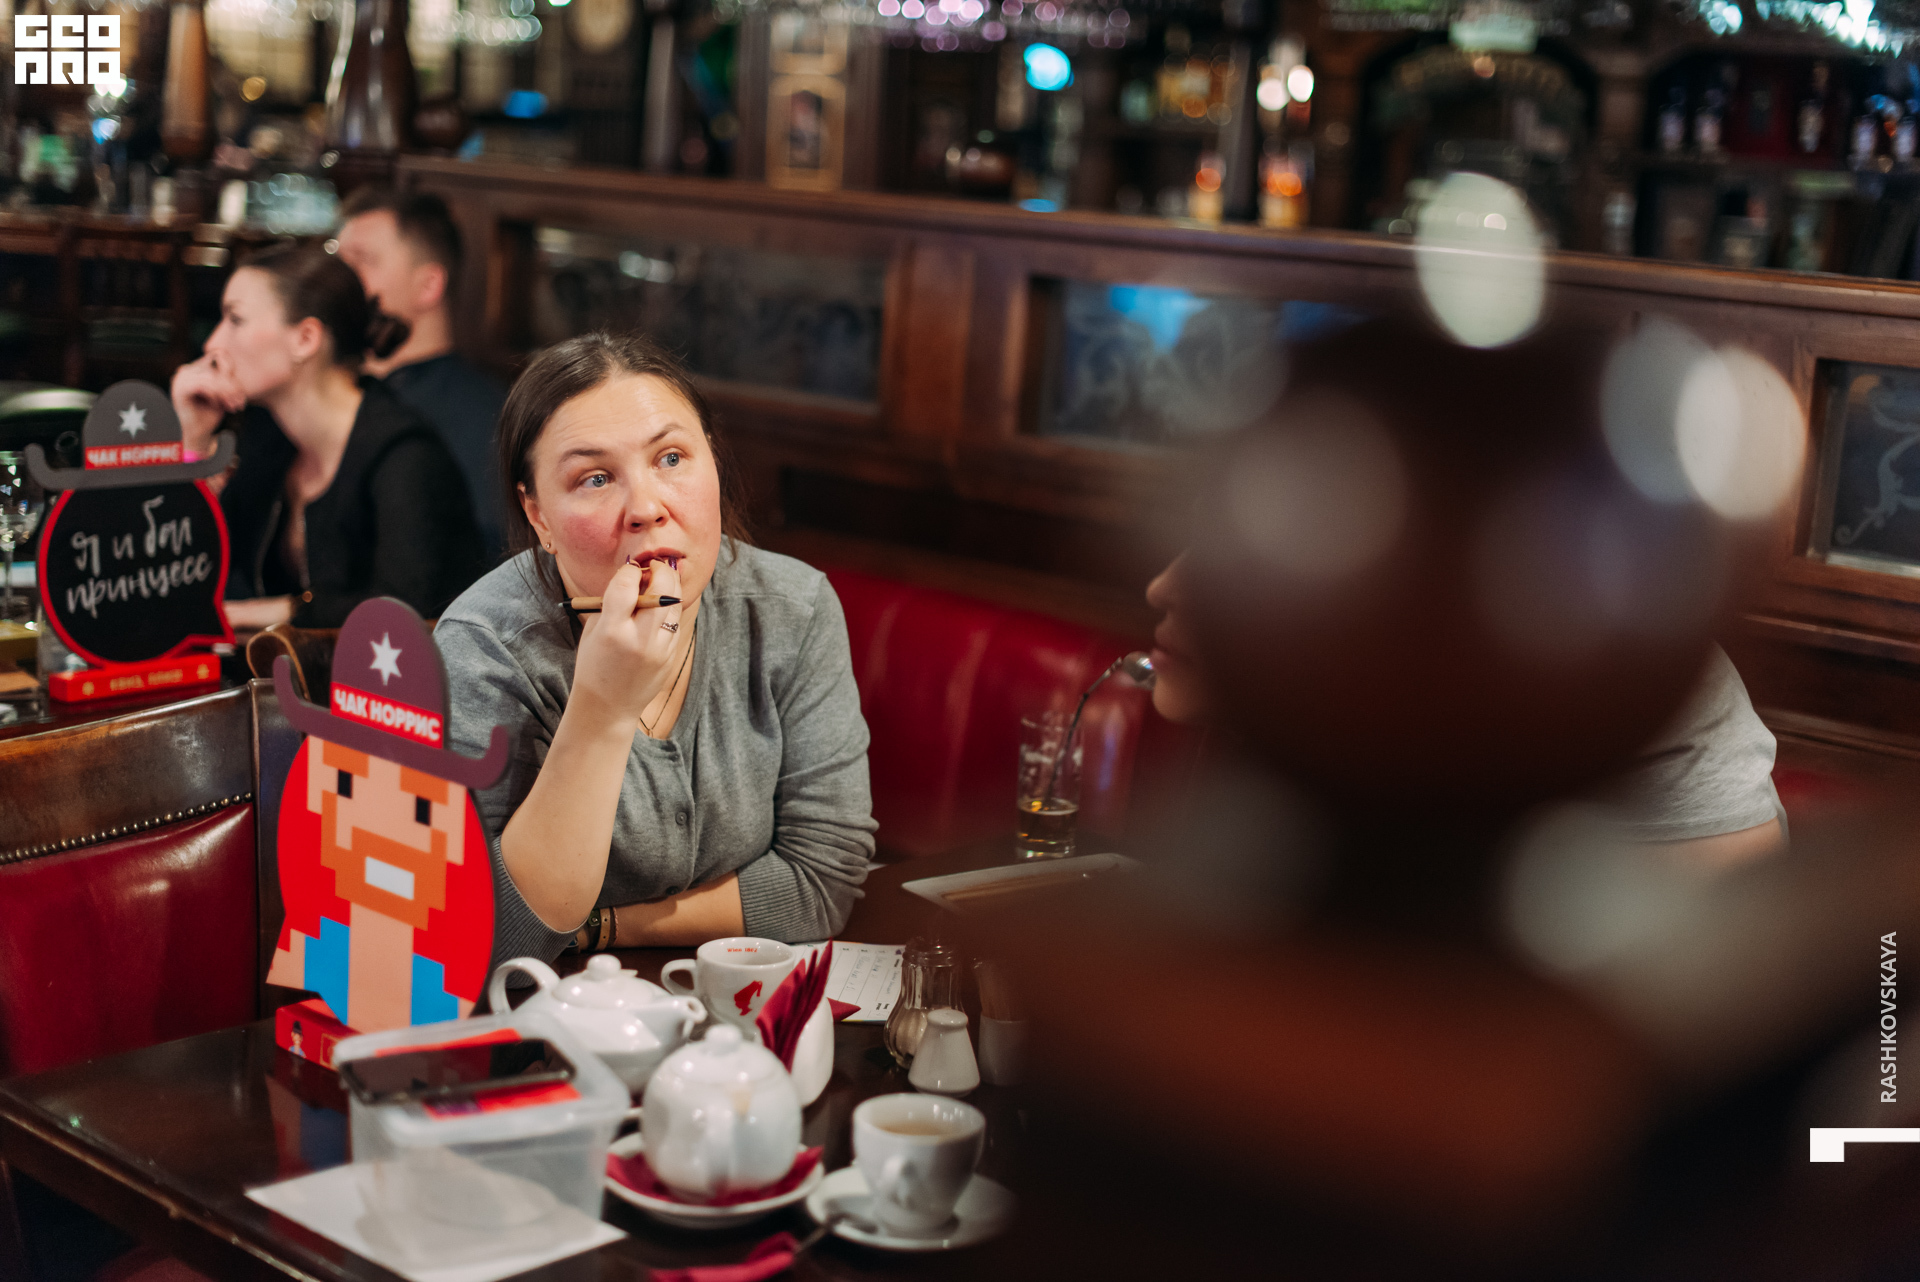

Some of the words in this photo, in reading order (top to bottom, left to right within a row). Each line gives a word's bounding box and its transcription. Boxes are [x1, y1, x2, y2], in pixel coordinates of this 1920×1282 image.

[87, 448, 118, 468] ЧАК
[334, 688, 368, 718] ЧАК
[369, 699, 440, 741] НОРРИС
